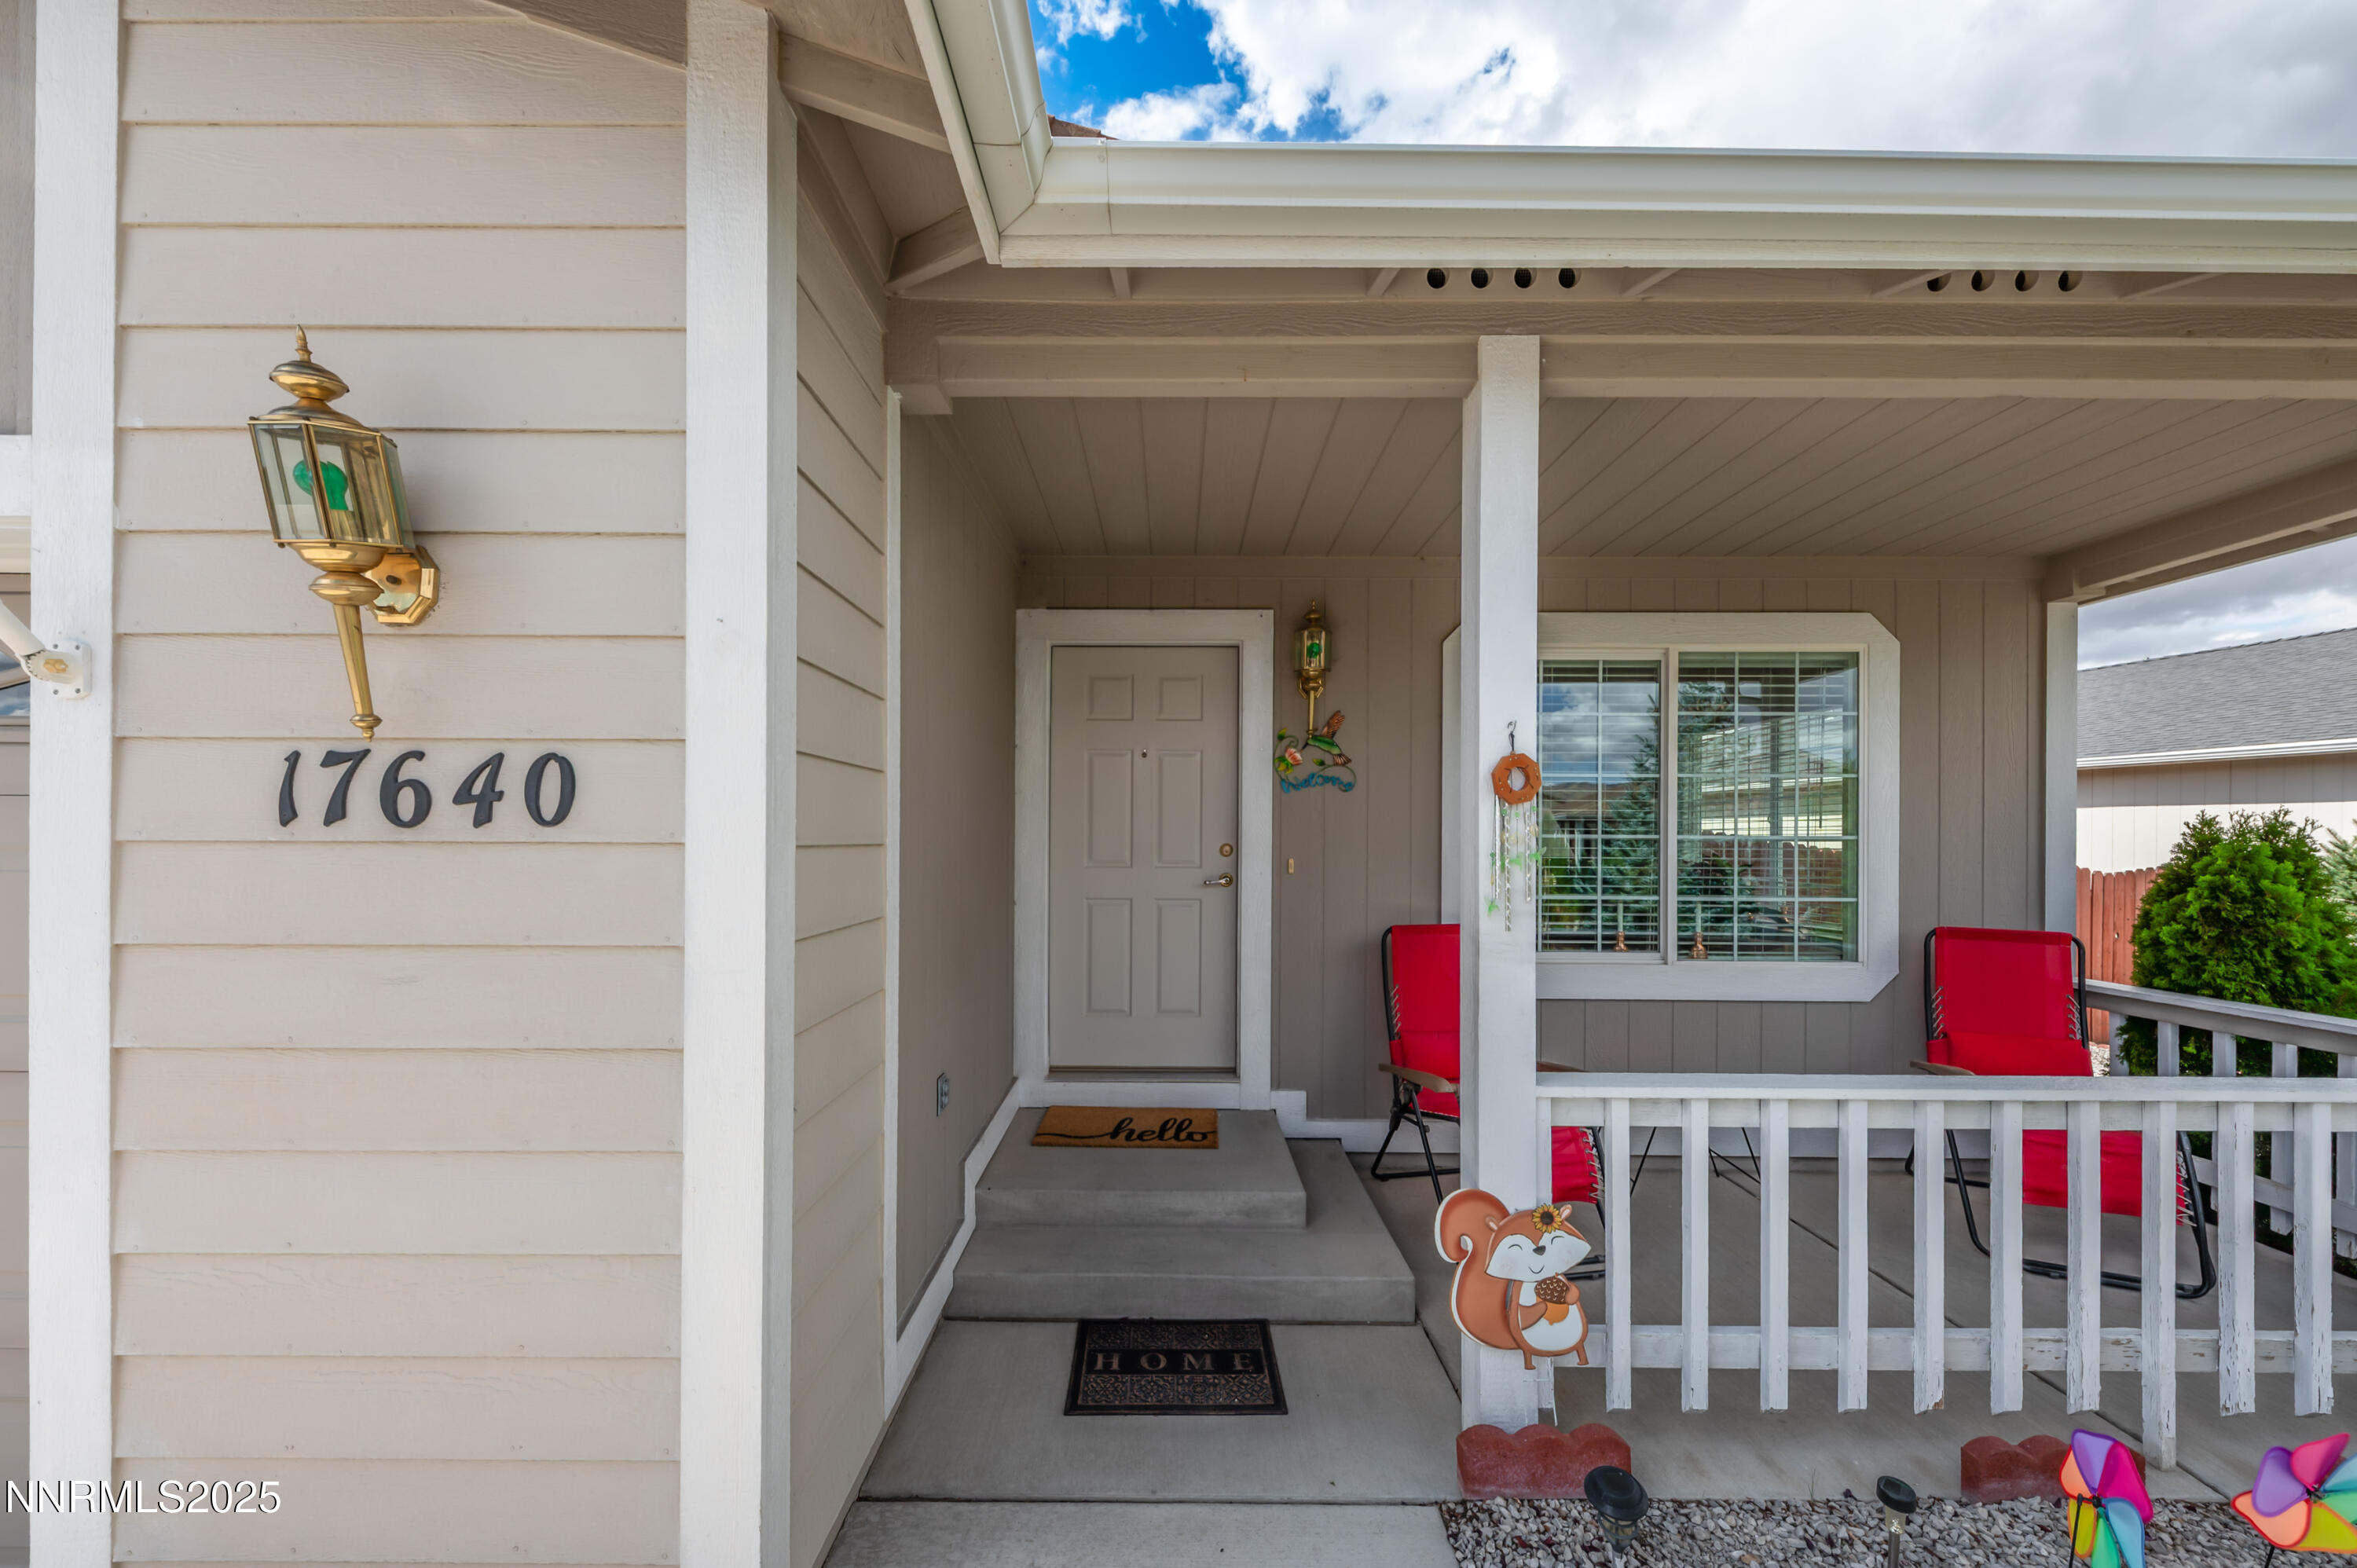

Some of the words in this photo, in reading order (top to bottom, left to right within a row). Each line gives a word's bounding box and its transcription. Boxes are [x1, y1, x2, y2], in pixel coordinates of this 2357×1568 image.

[278, 748, 576, 829] 17640
[1097, 1117, 1218, 1142] hello
[1094, 1352, 1255, 1371] HOME
